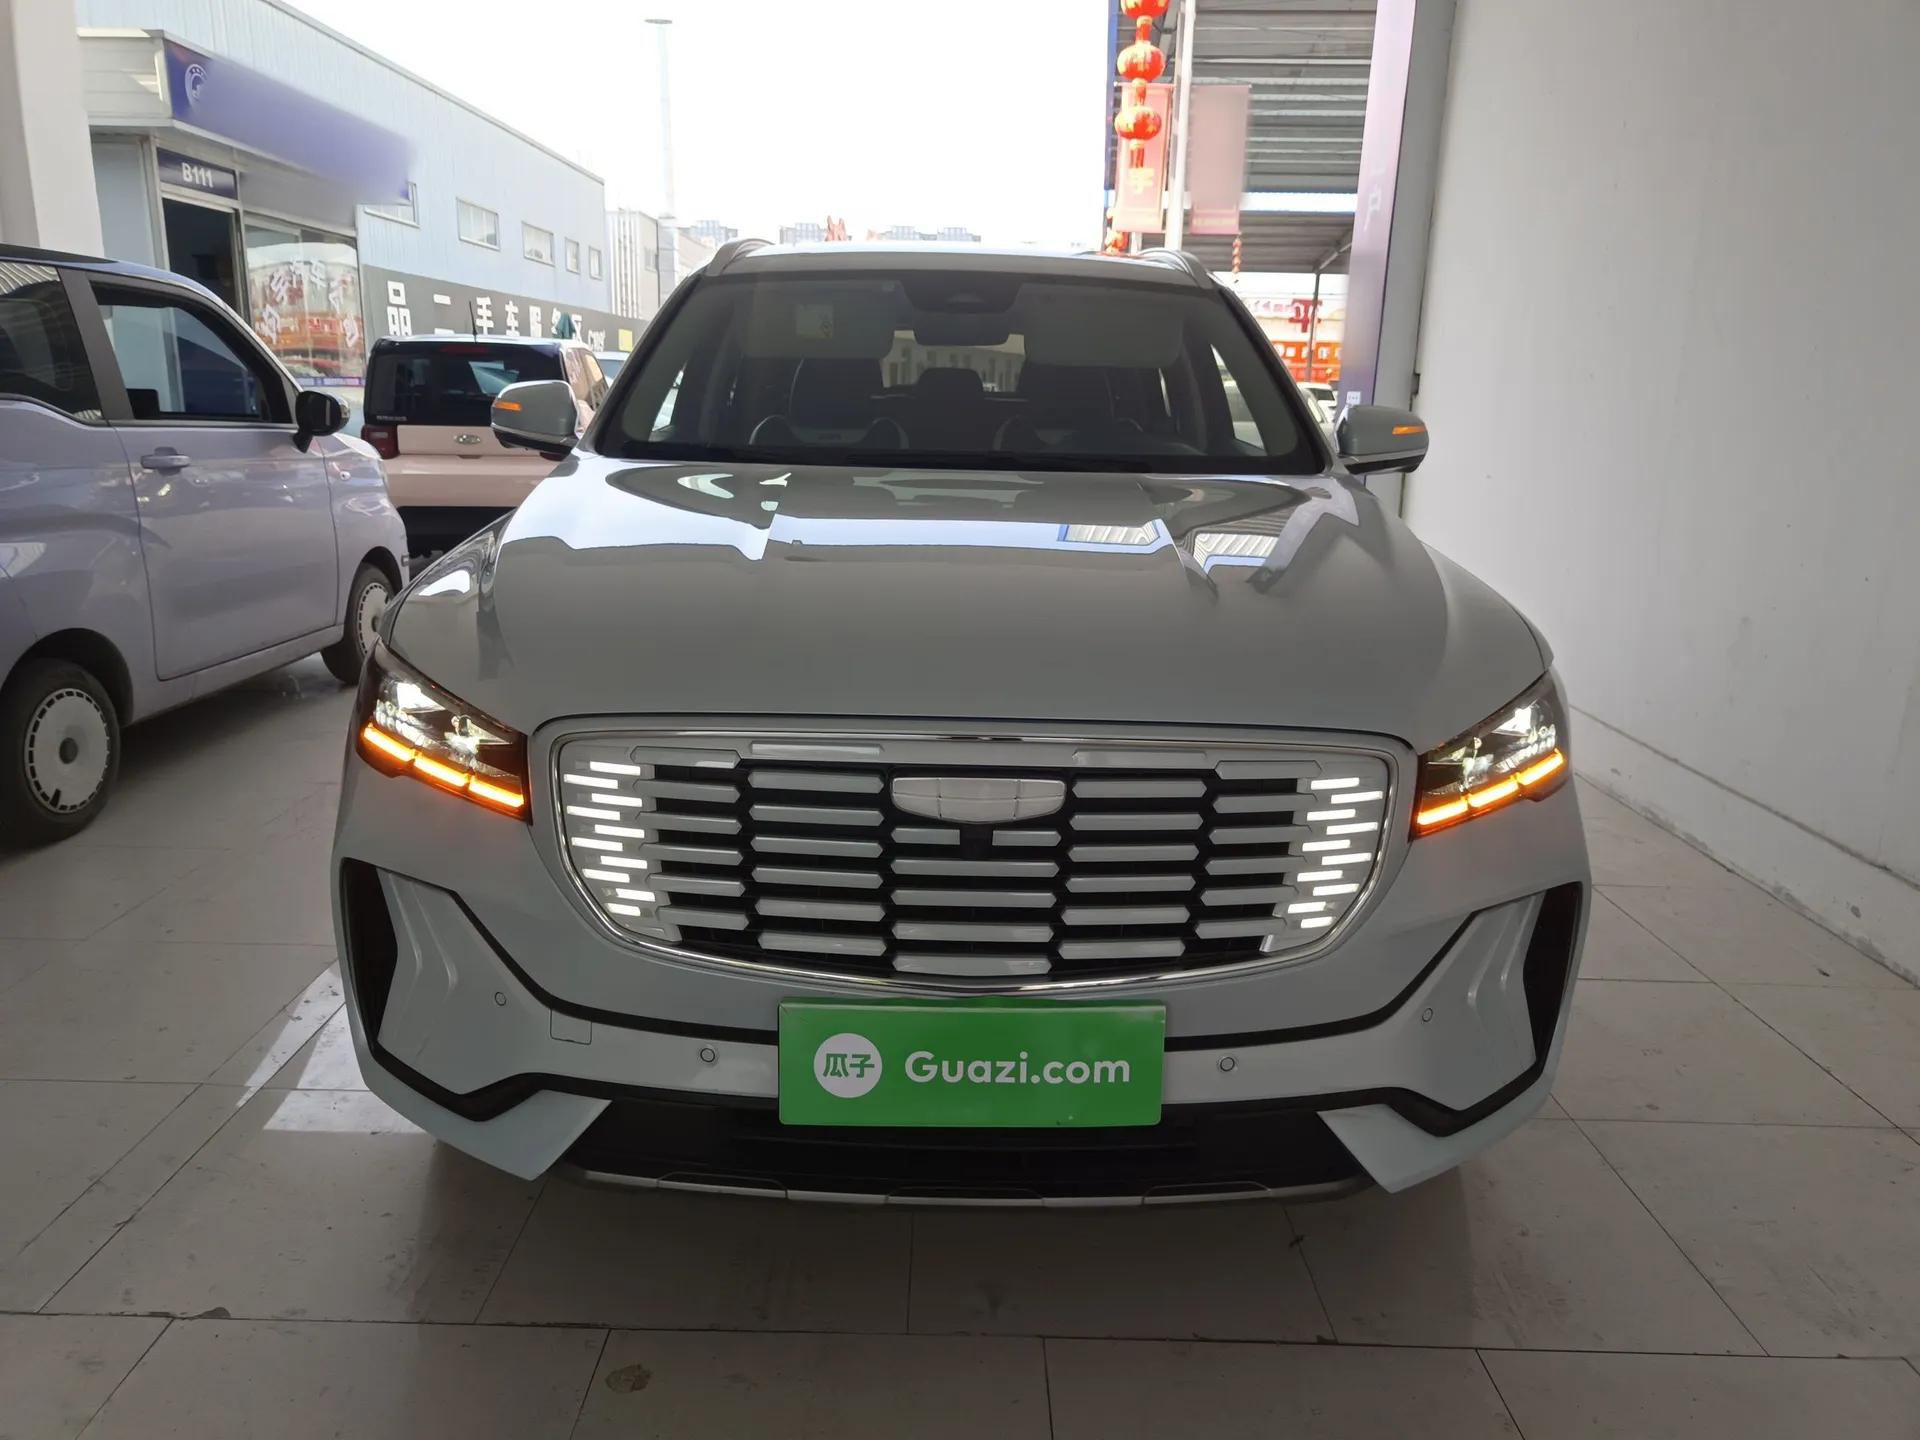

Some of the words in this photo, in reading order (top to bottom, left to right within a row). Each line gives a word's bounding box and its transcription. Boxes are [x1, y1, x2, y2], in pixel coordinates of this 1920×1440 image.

[182, 162, 213, 188] B111
[822, 1053, 875, 1079] 瓜子
[904, 1051, 1130, 1084] Guazi.com
